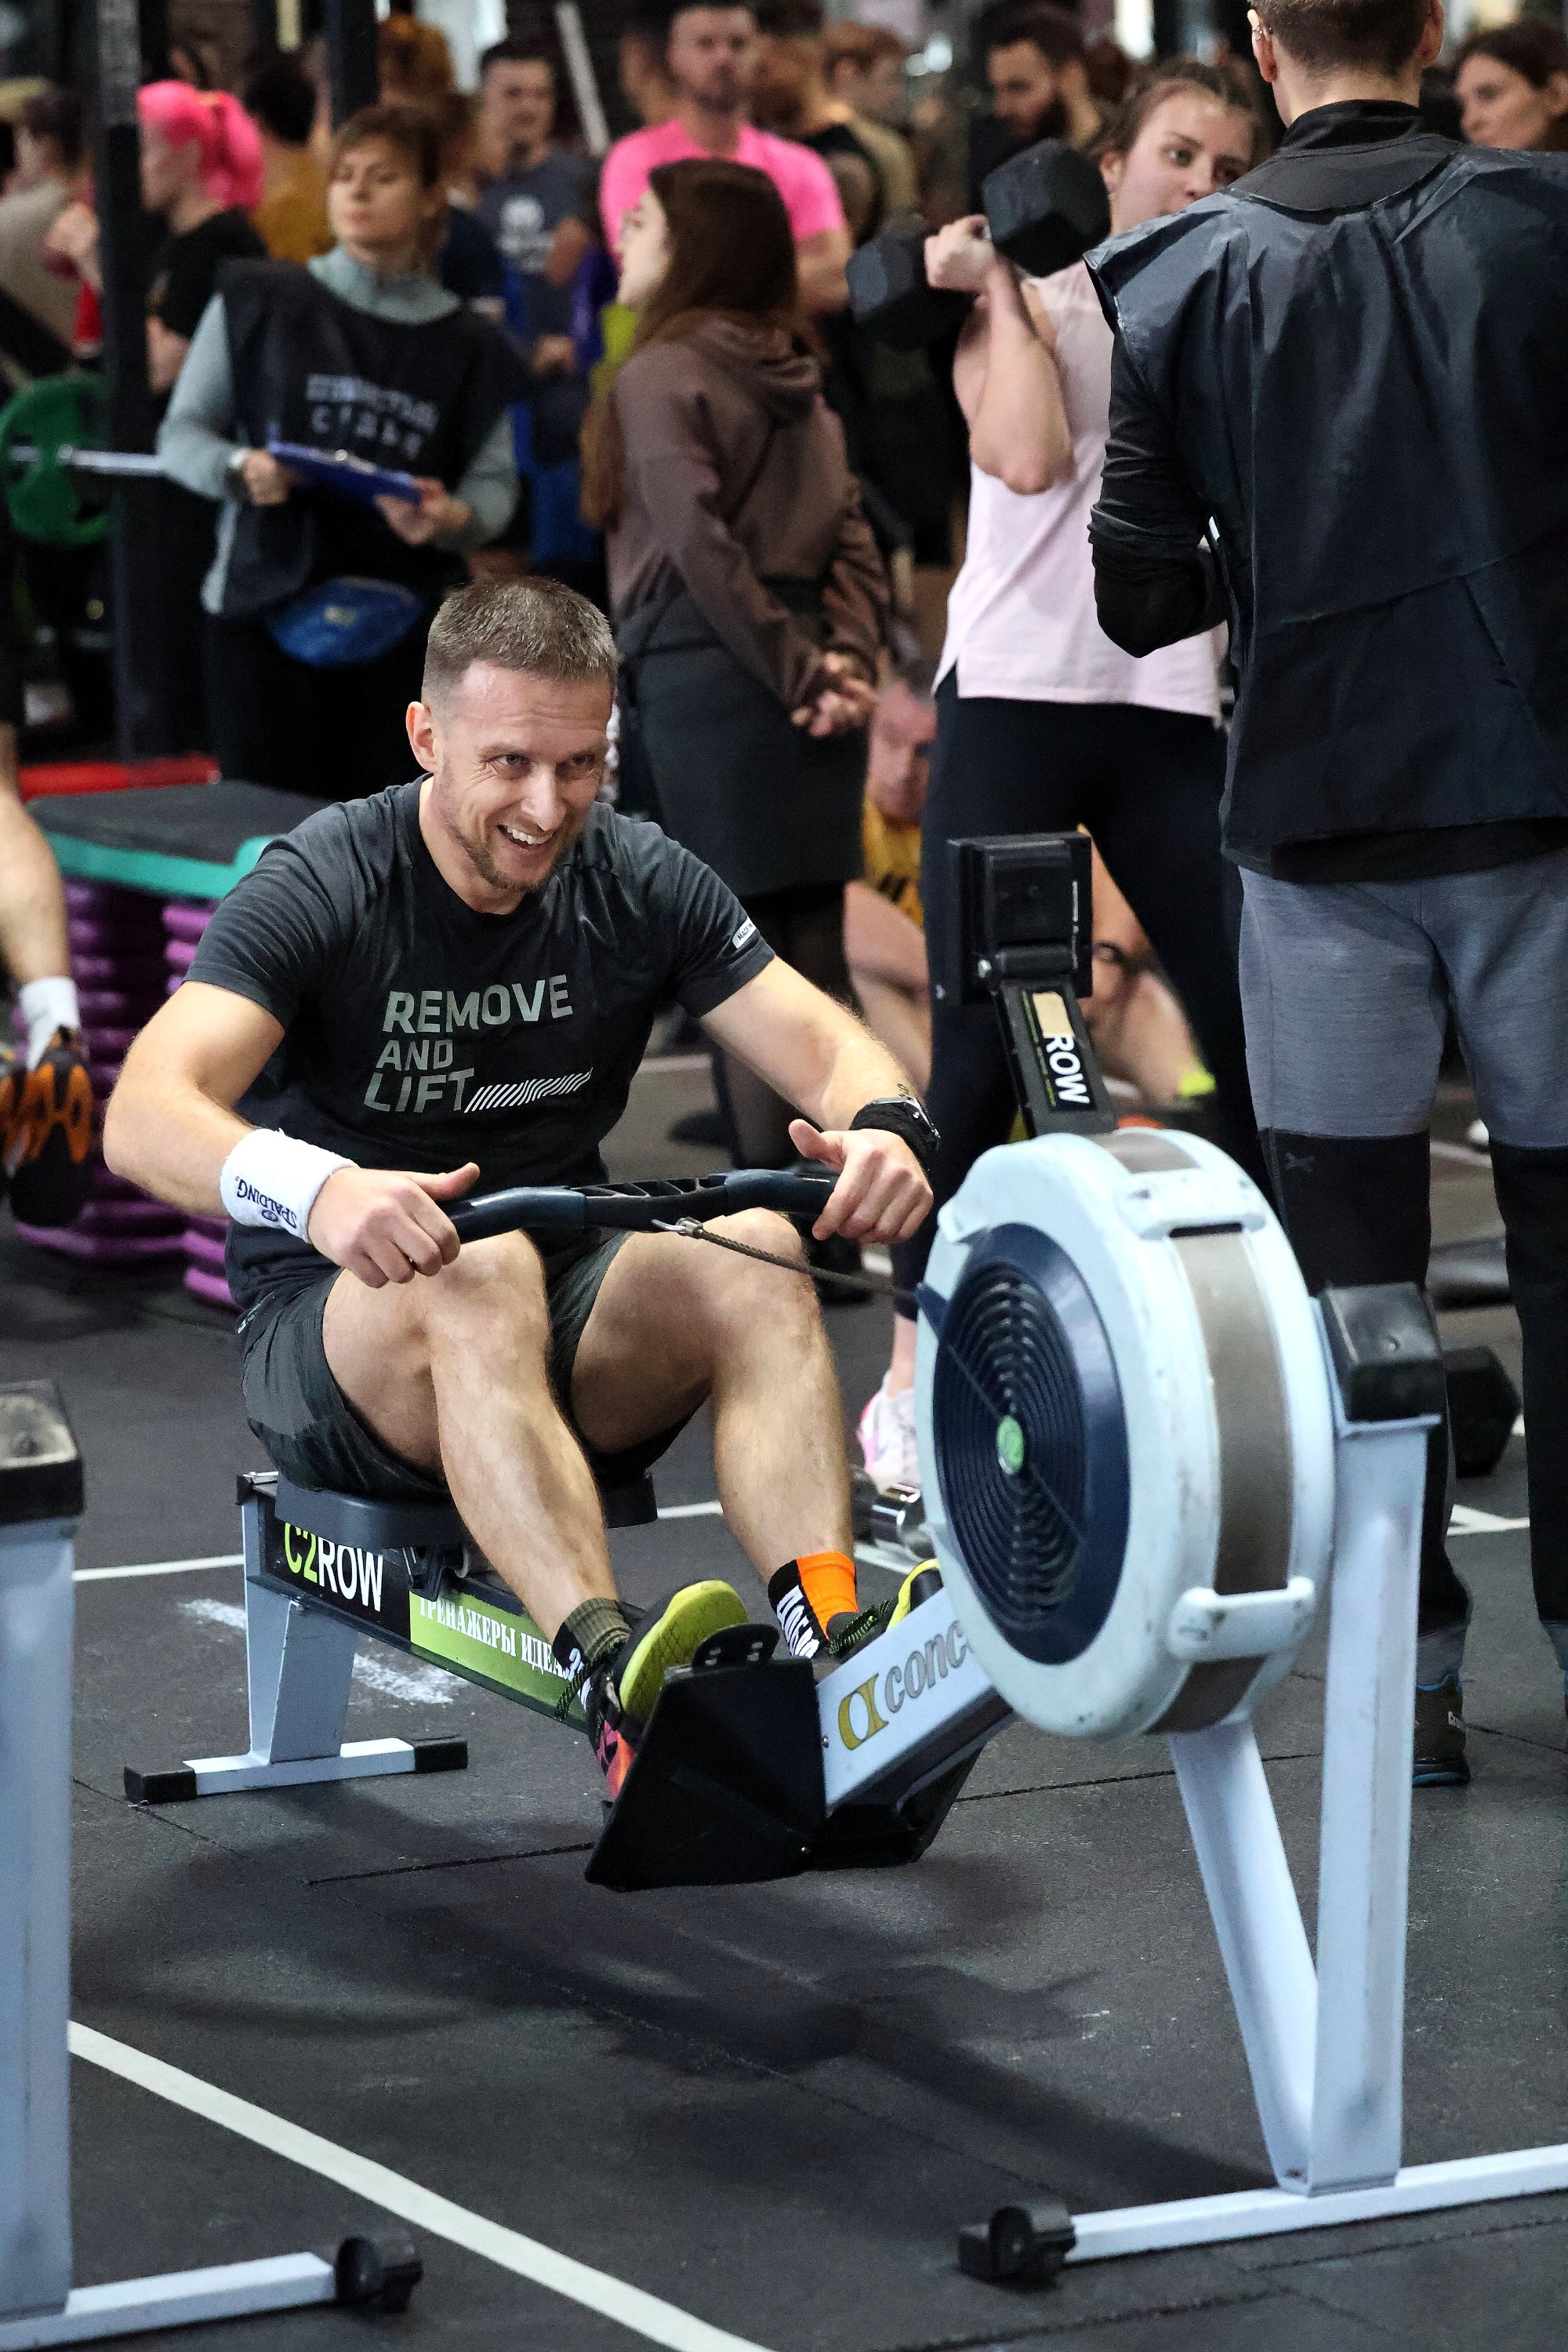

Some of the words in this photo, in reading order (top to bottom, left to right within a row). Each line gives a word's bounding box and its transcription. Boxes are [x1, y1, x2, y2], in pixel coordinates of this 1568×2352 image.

[382, 974, 573, 1034] REMOVE
[376, 1039, 454, 1072] AND
[363, 1067, 474, 1113] LIFT
[236, 1178, 297, 1229] SPALDING
[284, 1522, 383, 1613] C2ROW
[520, 1632, 568, 1680] ИДЕА
[884, 1619, 970, 1715] conc
